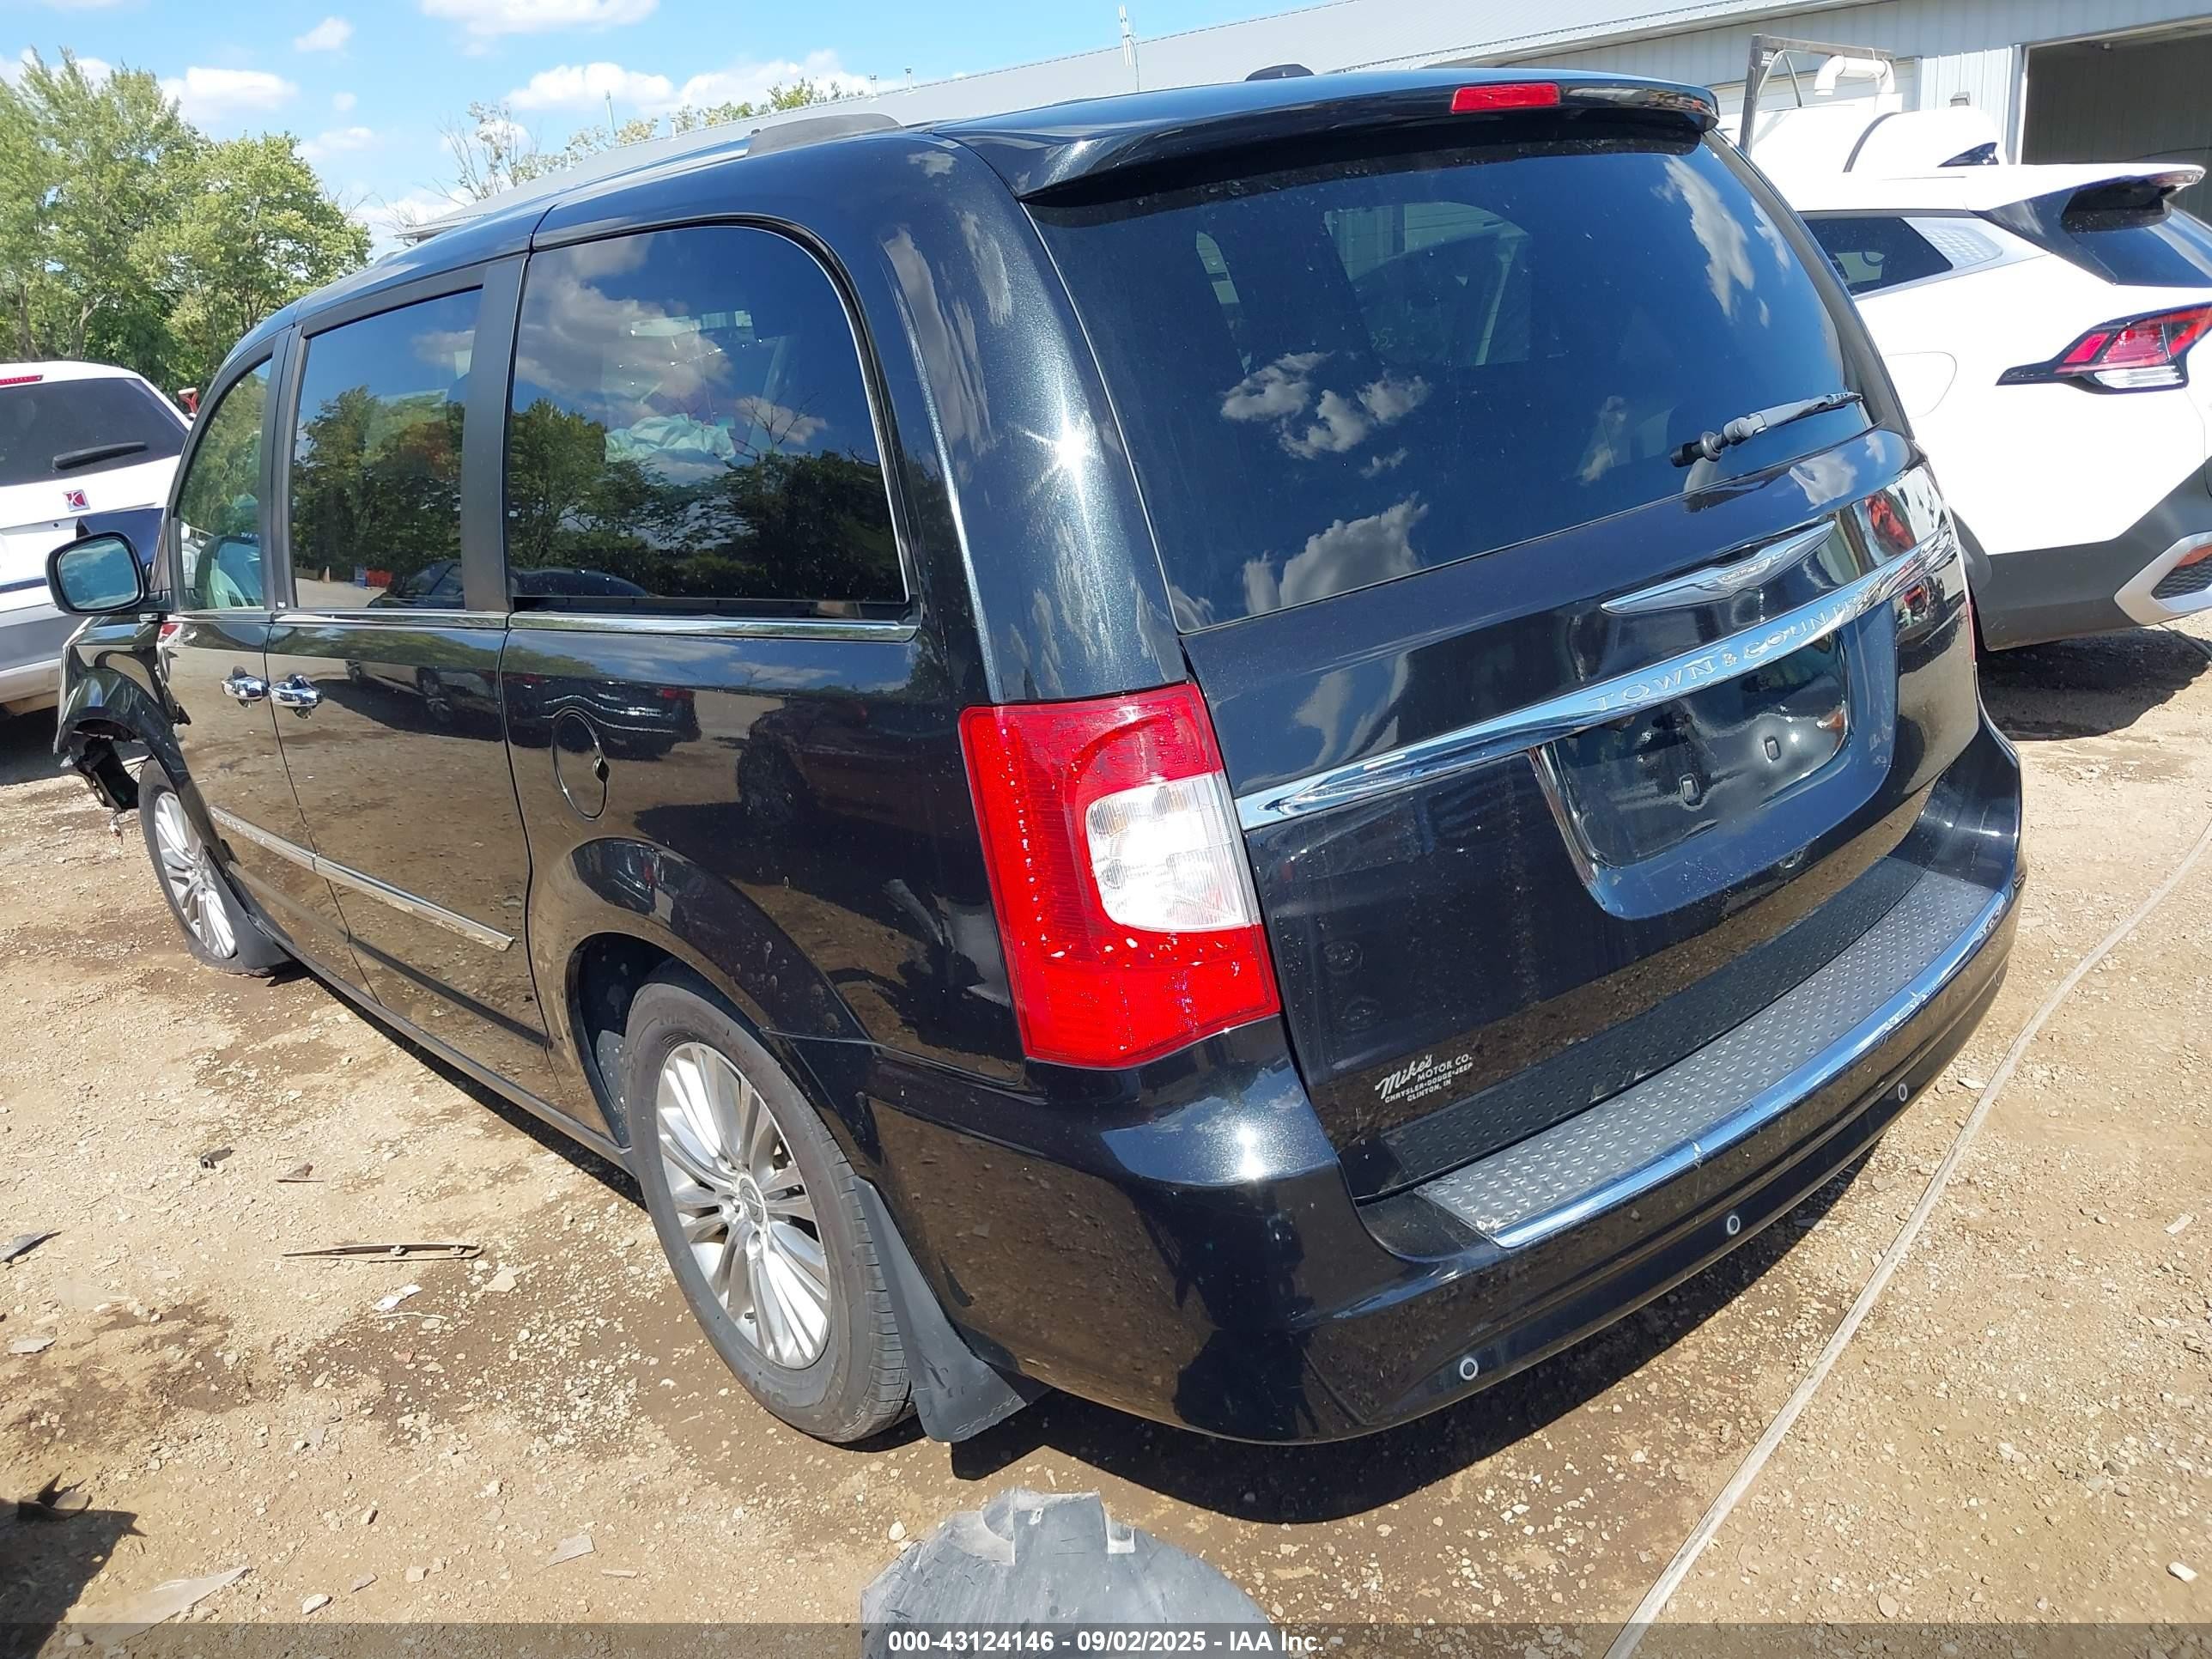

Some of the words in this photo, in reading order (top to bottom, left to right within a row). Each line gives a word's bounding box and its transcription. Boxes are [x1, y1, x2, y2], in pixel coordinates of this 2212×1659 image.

[1587, 655, 1718, 712] TOWN
[1722, 651, 1738, 667] &
[1374, 1054, 1433, 1100] Mike's
[1417, 1060, 1452, 1083] MOTOR
[1455, 1053, 1473, 1066] CO.
[1443, 1078, 1451, 1086] IN
